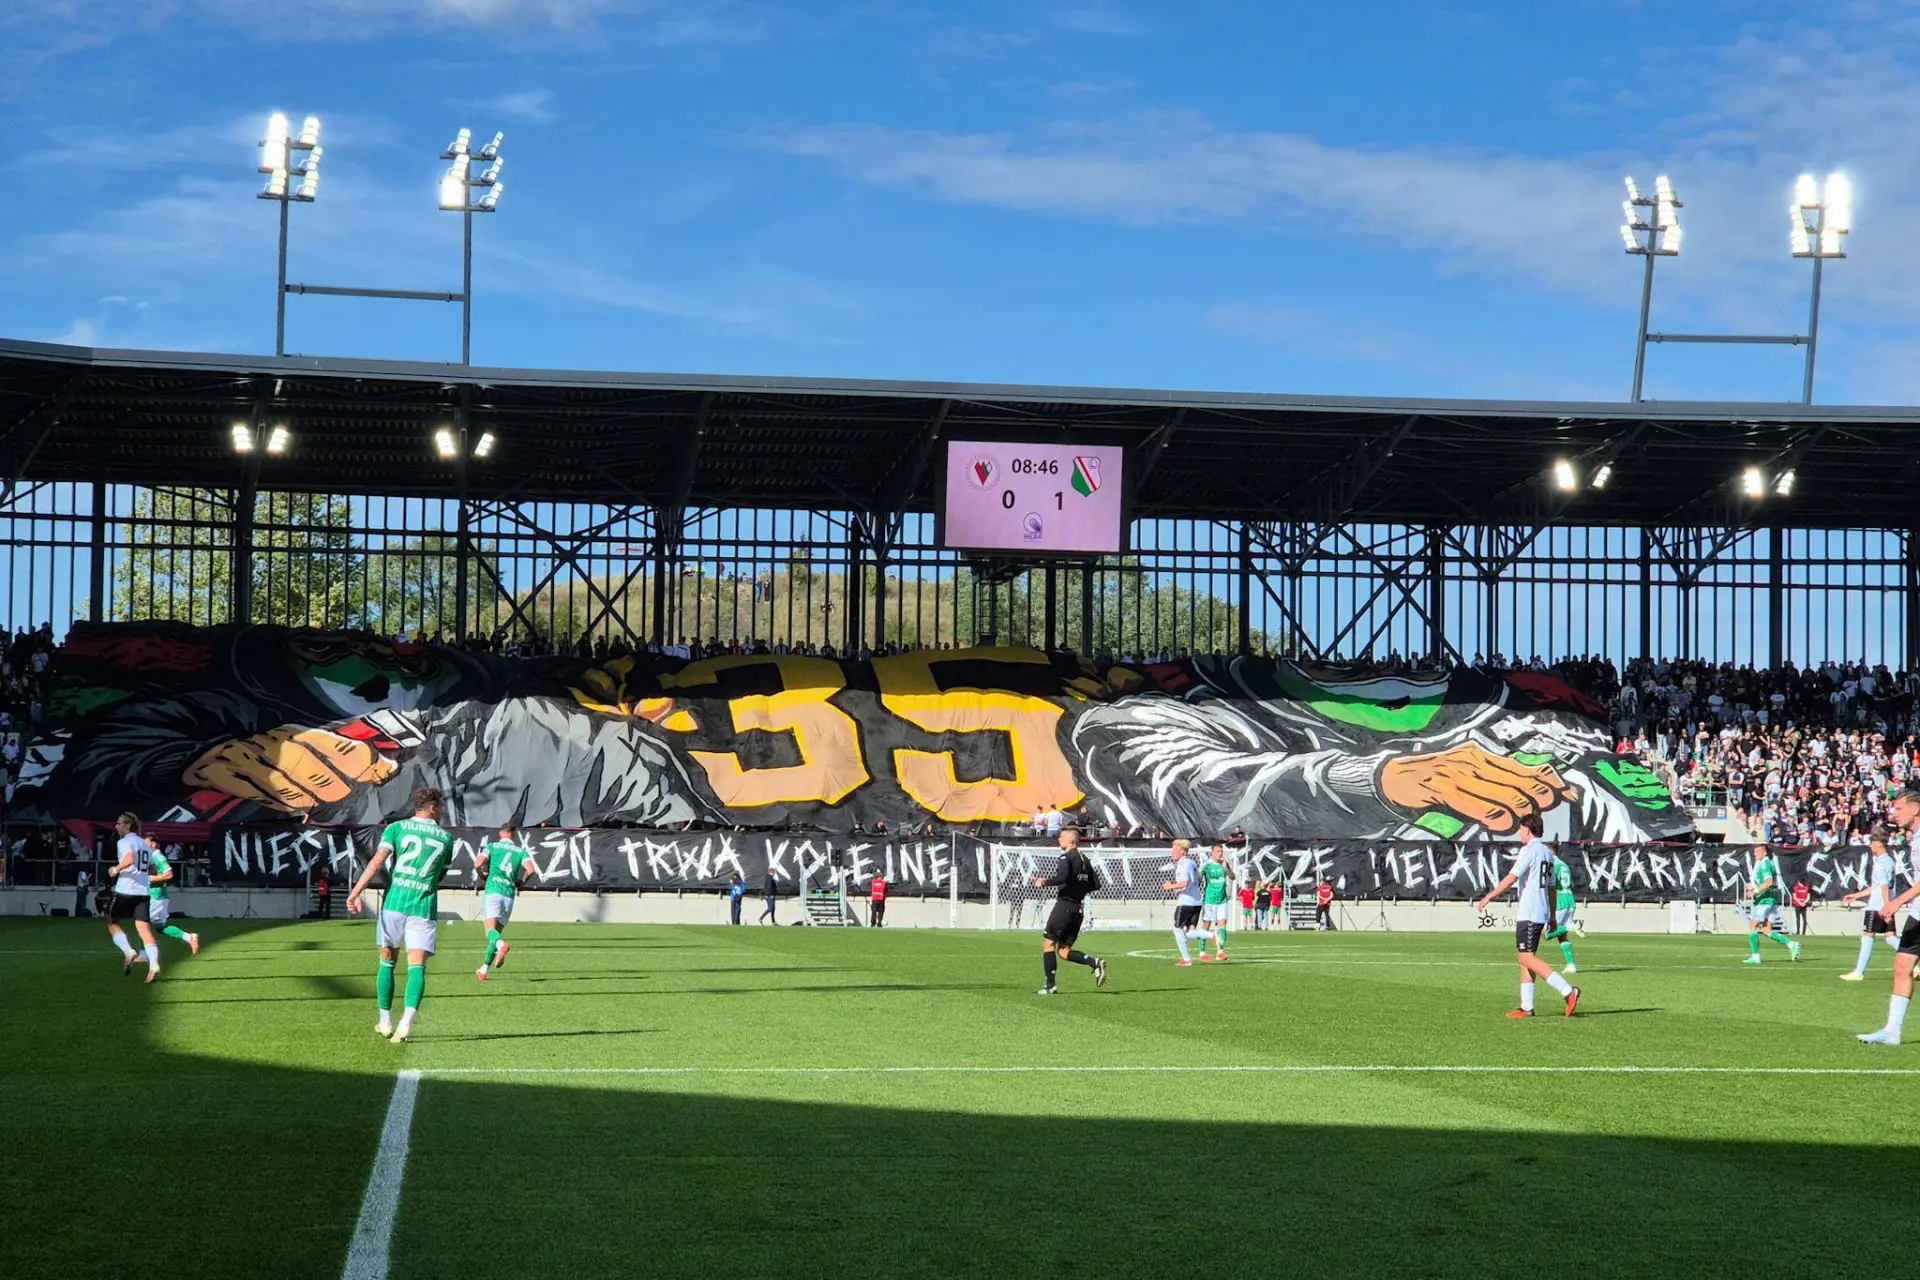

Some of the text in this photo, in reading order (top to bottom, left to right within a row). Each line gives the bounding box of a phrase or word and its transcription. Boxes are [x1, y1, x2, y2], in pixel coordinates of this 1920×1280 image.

[1012, 458, 1058, 475] 08:46
[1002, 489, 1015, 509] 0
[1055, 491, 1063, 510] 1
[400, 820, 448, 840] VIUNNYK
[137, 849, 149, 872] 19
[224, 829, 358, 877] NIECH
[618, 833, 744, 882] TRWA
[765, 839, 951, 888] KOLEJNE
[395, 834, 444, 878] 27
[500, 852, 513, 878] 4
[392, 877, 431, 891] FORTUN
